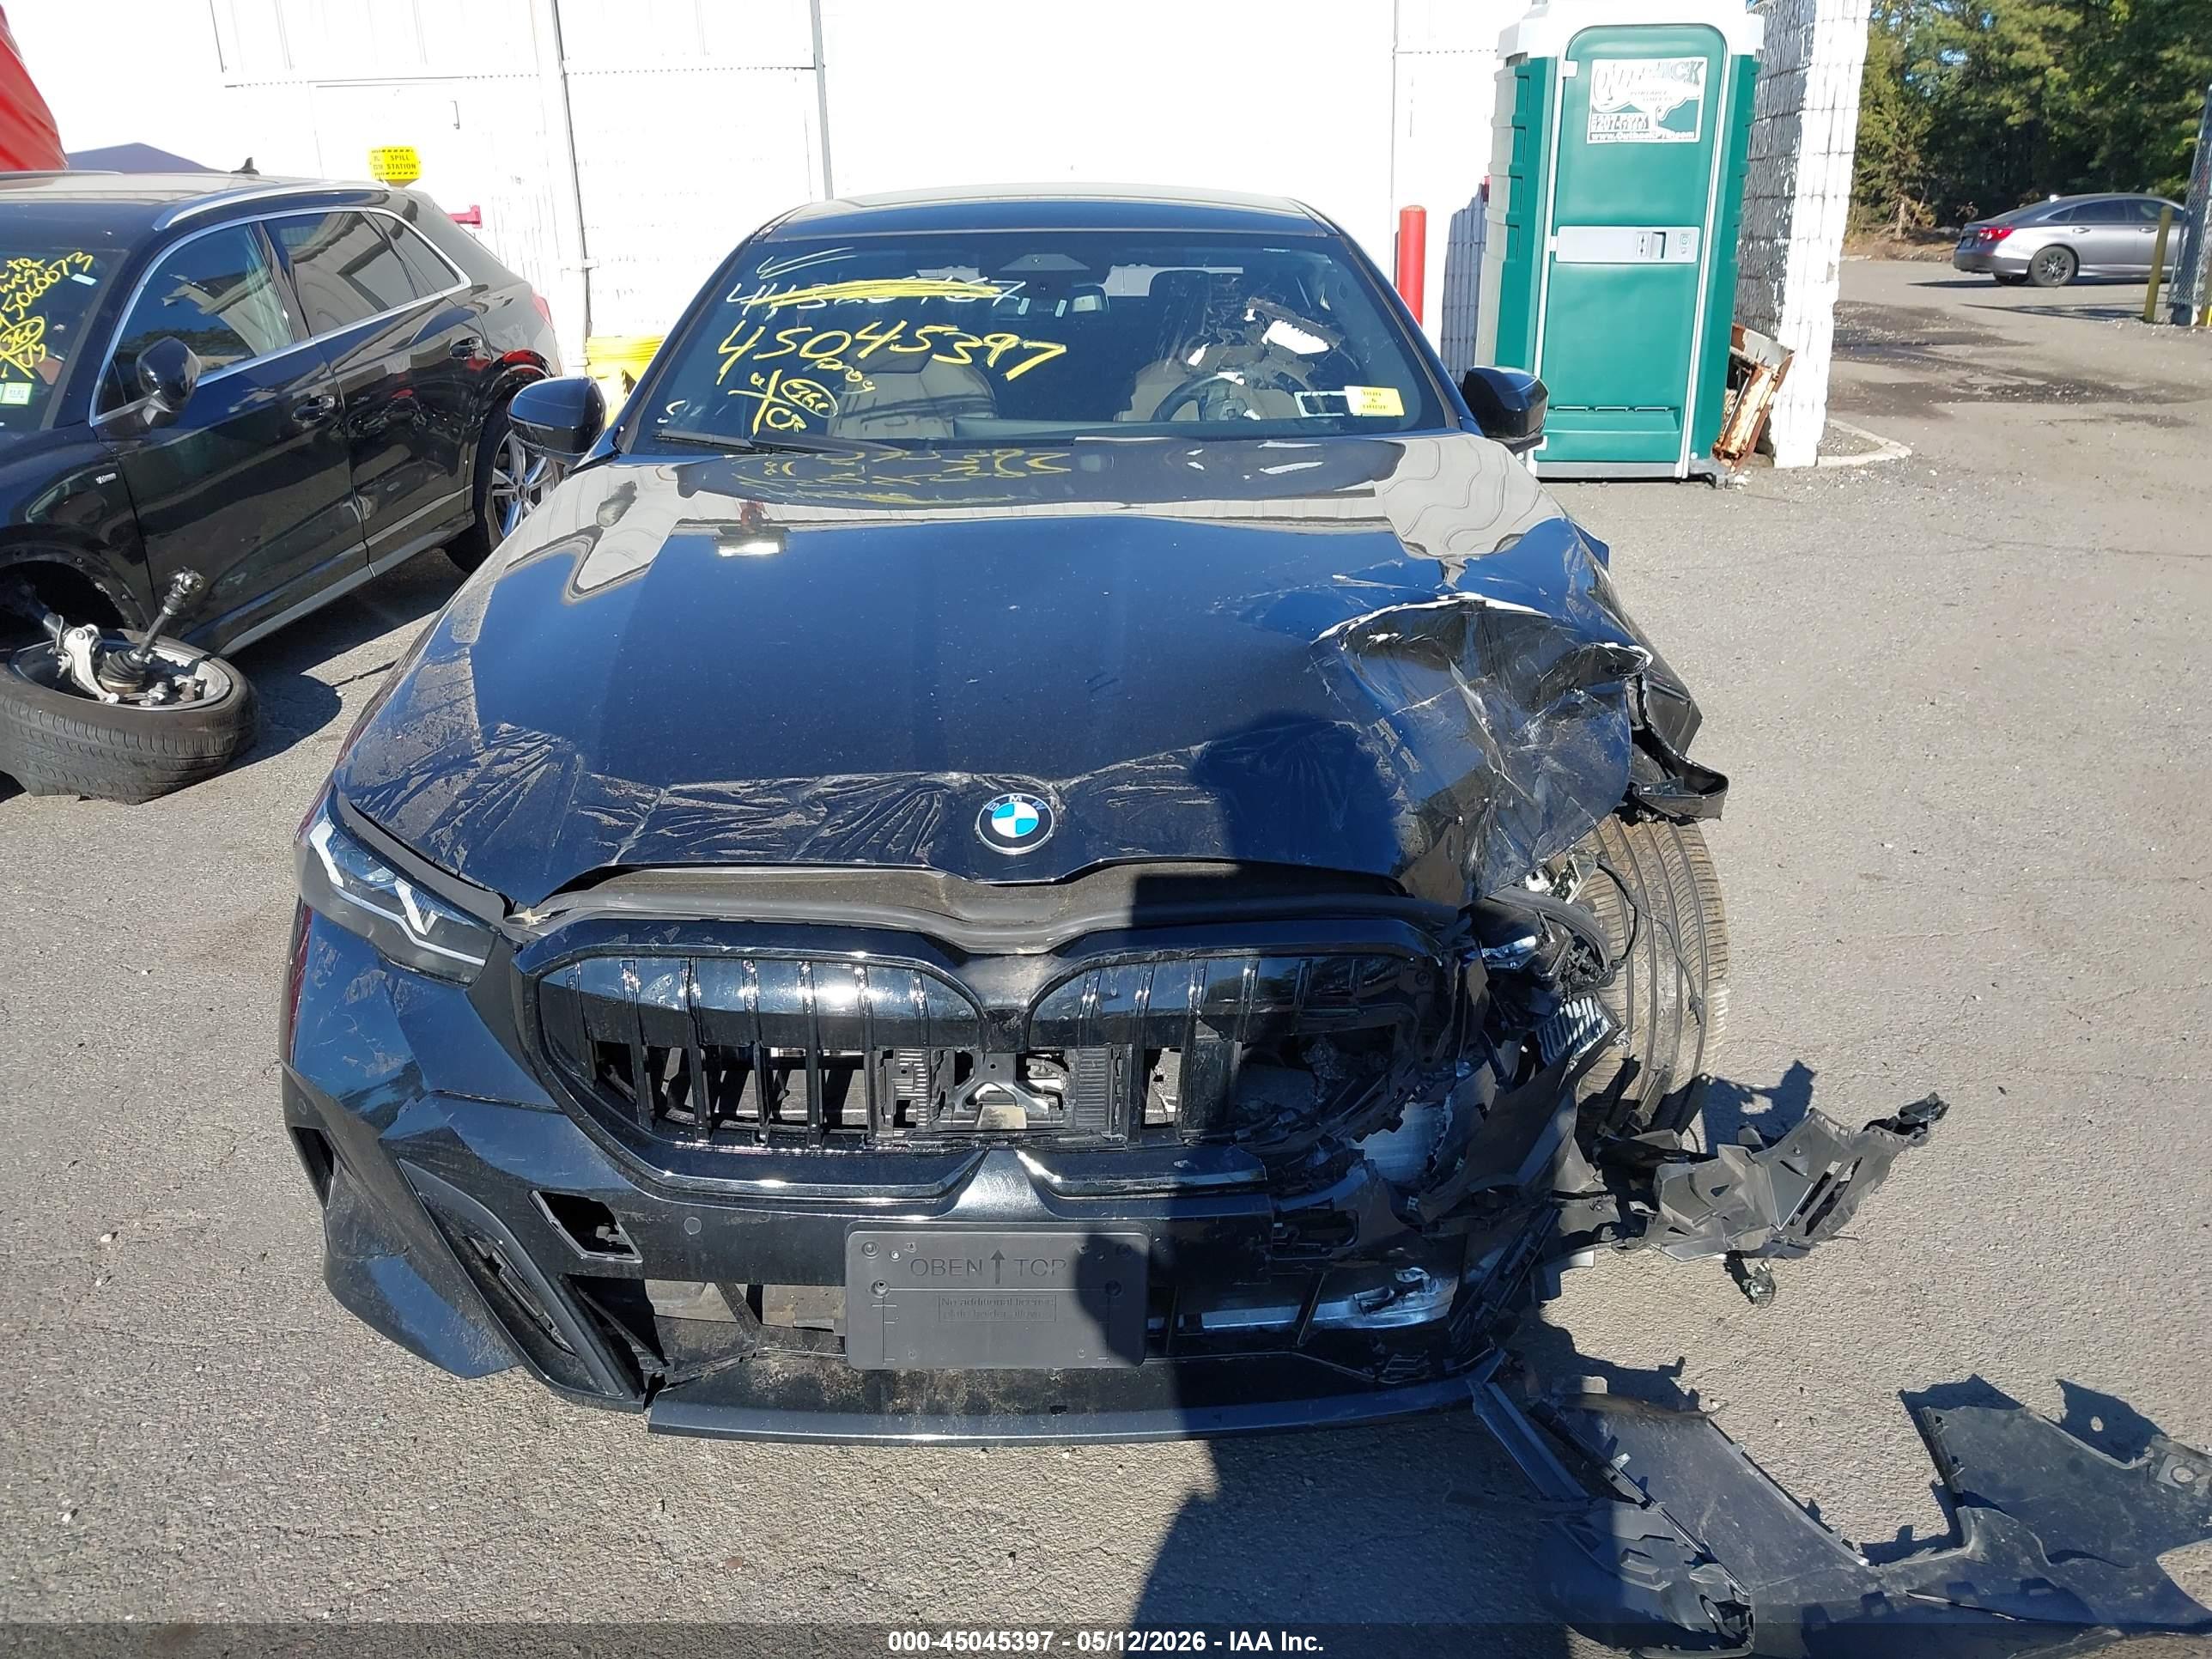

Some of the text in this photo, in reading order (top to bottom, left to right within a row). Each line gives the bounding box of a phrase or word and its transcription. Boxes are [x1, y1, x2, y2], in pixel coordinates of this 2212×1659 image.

[715, 319, 1067, 385] 45045397
[987, 795, 1047, 811] BMW
[910, 1258, 1067, 1277] OBEN TOP
[960, 1297, 1012, 1306] additional
